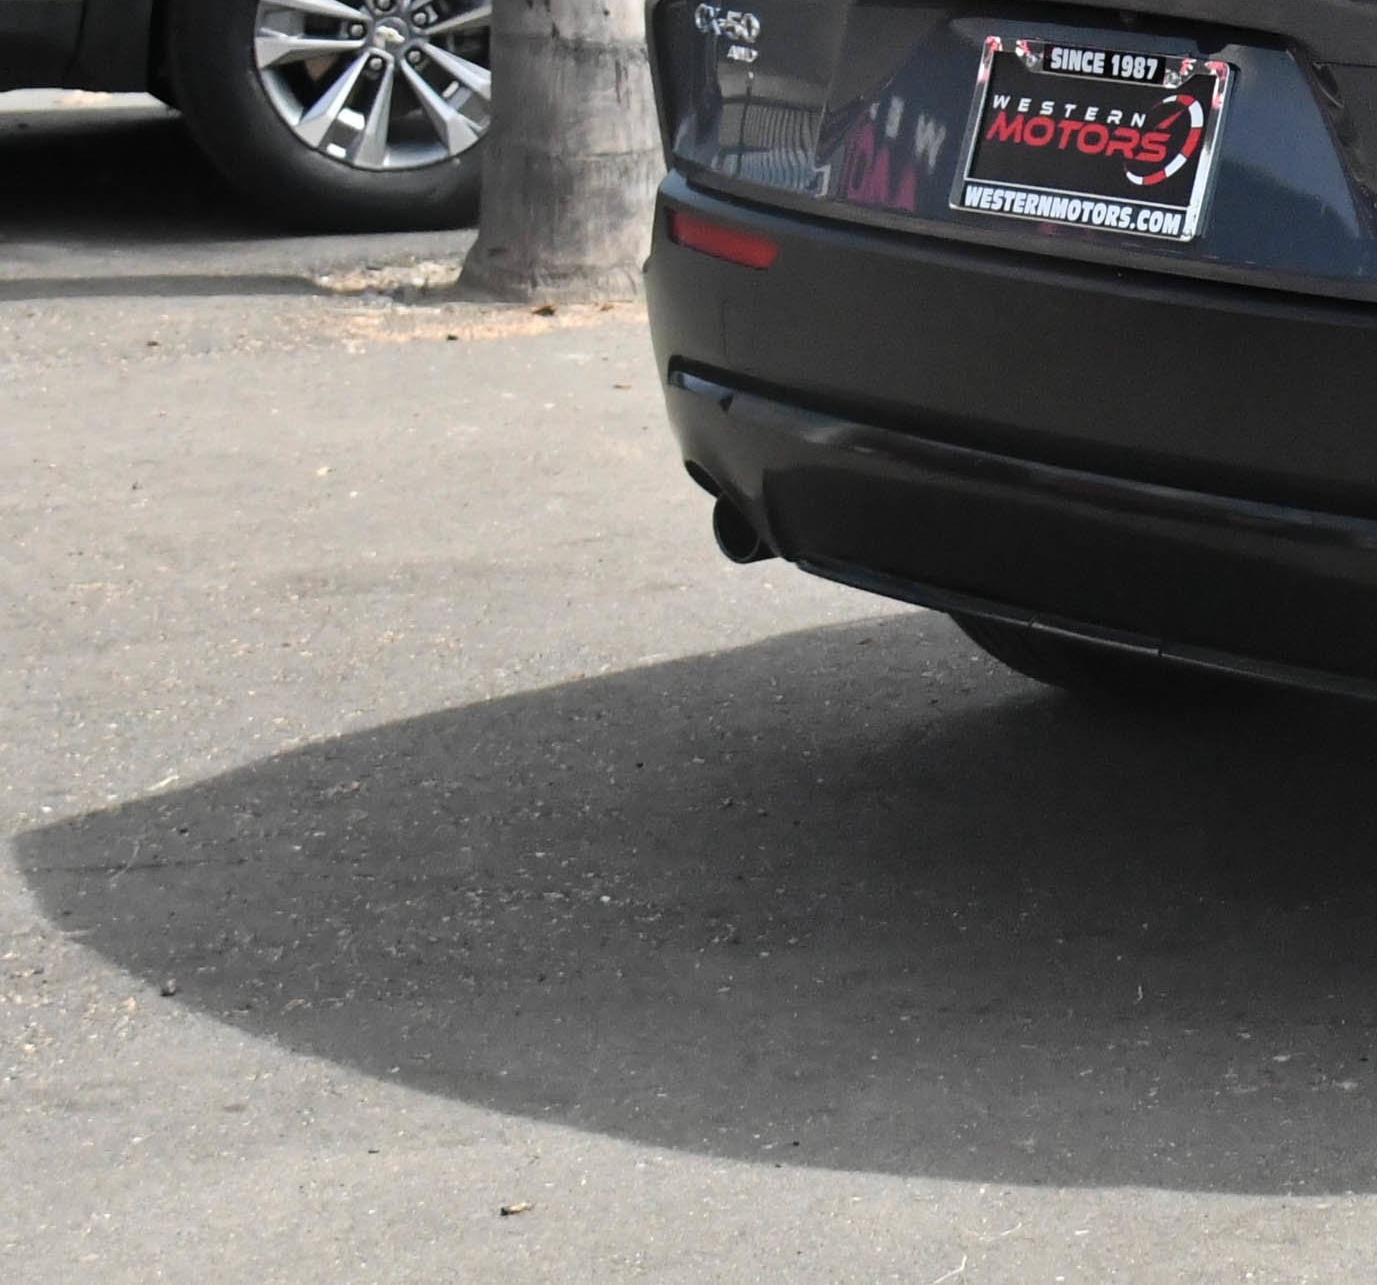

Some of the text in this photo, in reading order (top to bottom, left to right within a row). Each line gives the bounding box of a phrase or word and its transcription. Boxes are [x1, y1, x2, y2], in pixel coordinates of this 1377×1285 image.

[1050, 47, 1158, 81] SINCE 1987
[992, 94, 1147, 129] WESTERN
[986, 111, 1171, 163] MOTORS
[963, 185, 1184, 235] WESTERNMOTORS.COM
